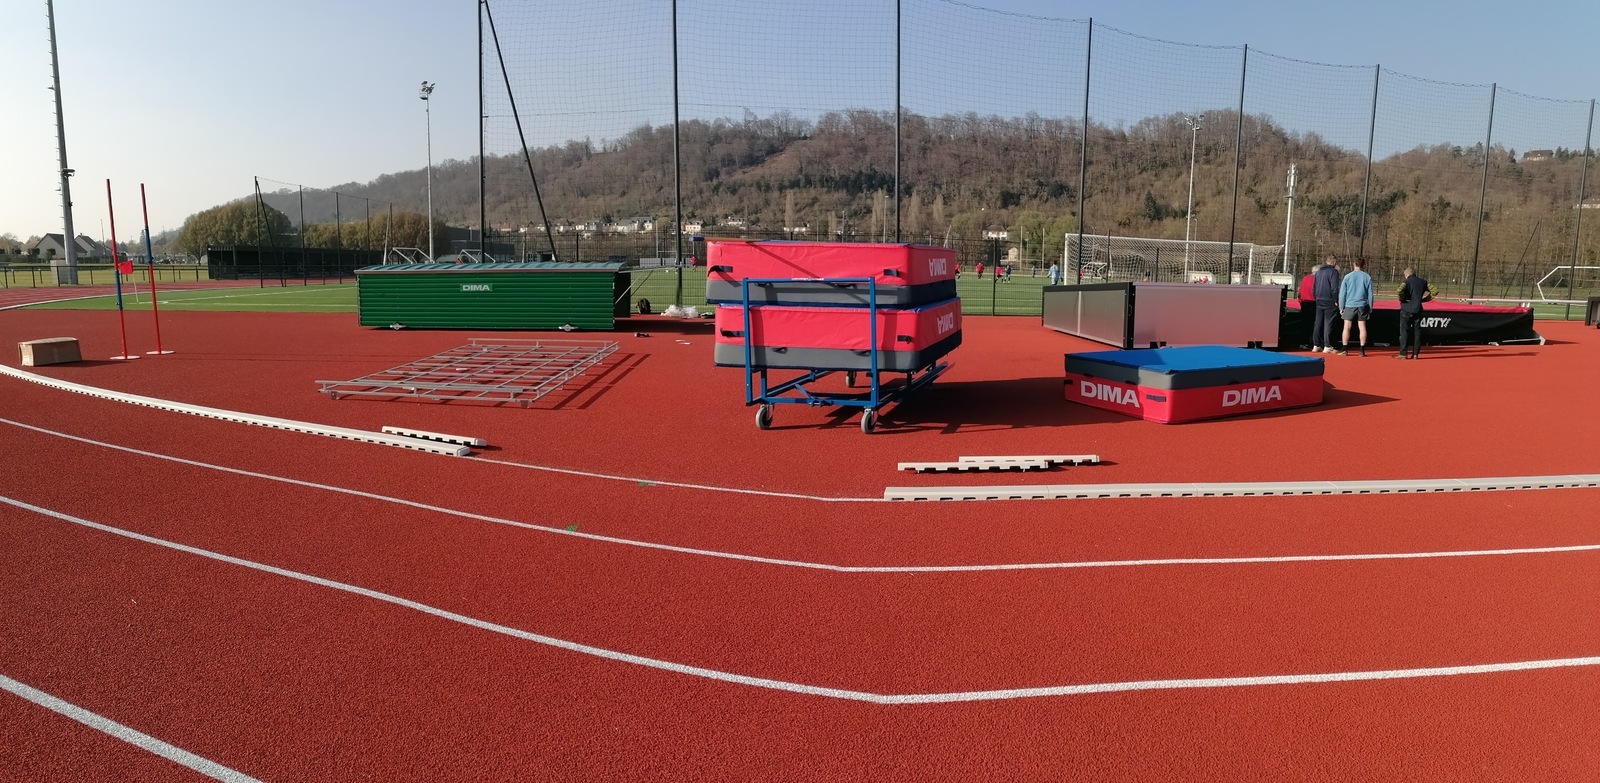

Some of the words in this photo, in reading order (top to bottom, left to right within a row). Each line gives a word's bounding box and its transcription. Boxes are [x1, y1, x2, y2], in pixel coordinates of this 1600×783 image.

[928, 258, 947, 277] DIMA
[936, 311, 954, 335] DIMA
[1411, 317, 1448, 328] ARTY
[1080, 380, 1140, 408] DIMA
[1222, 385, 1282, 408] DIMA
